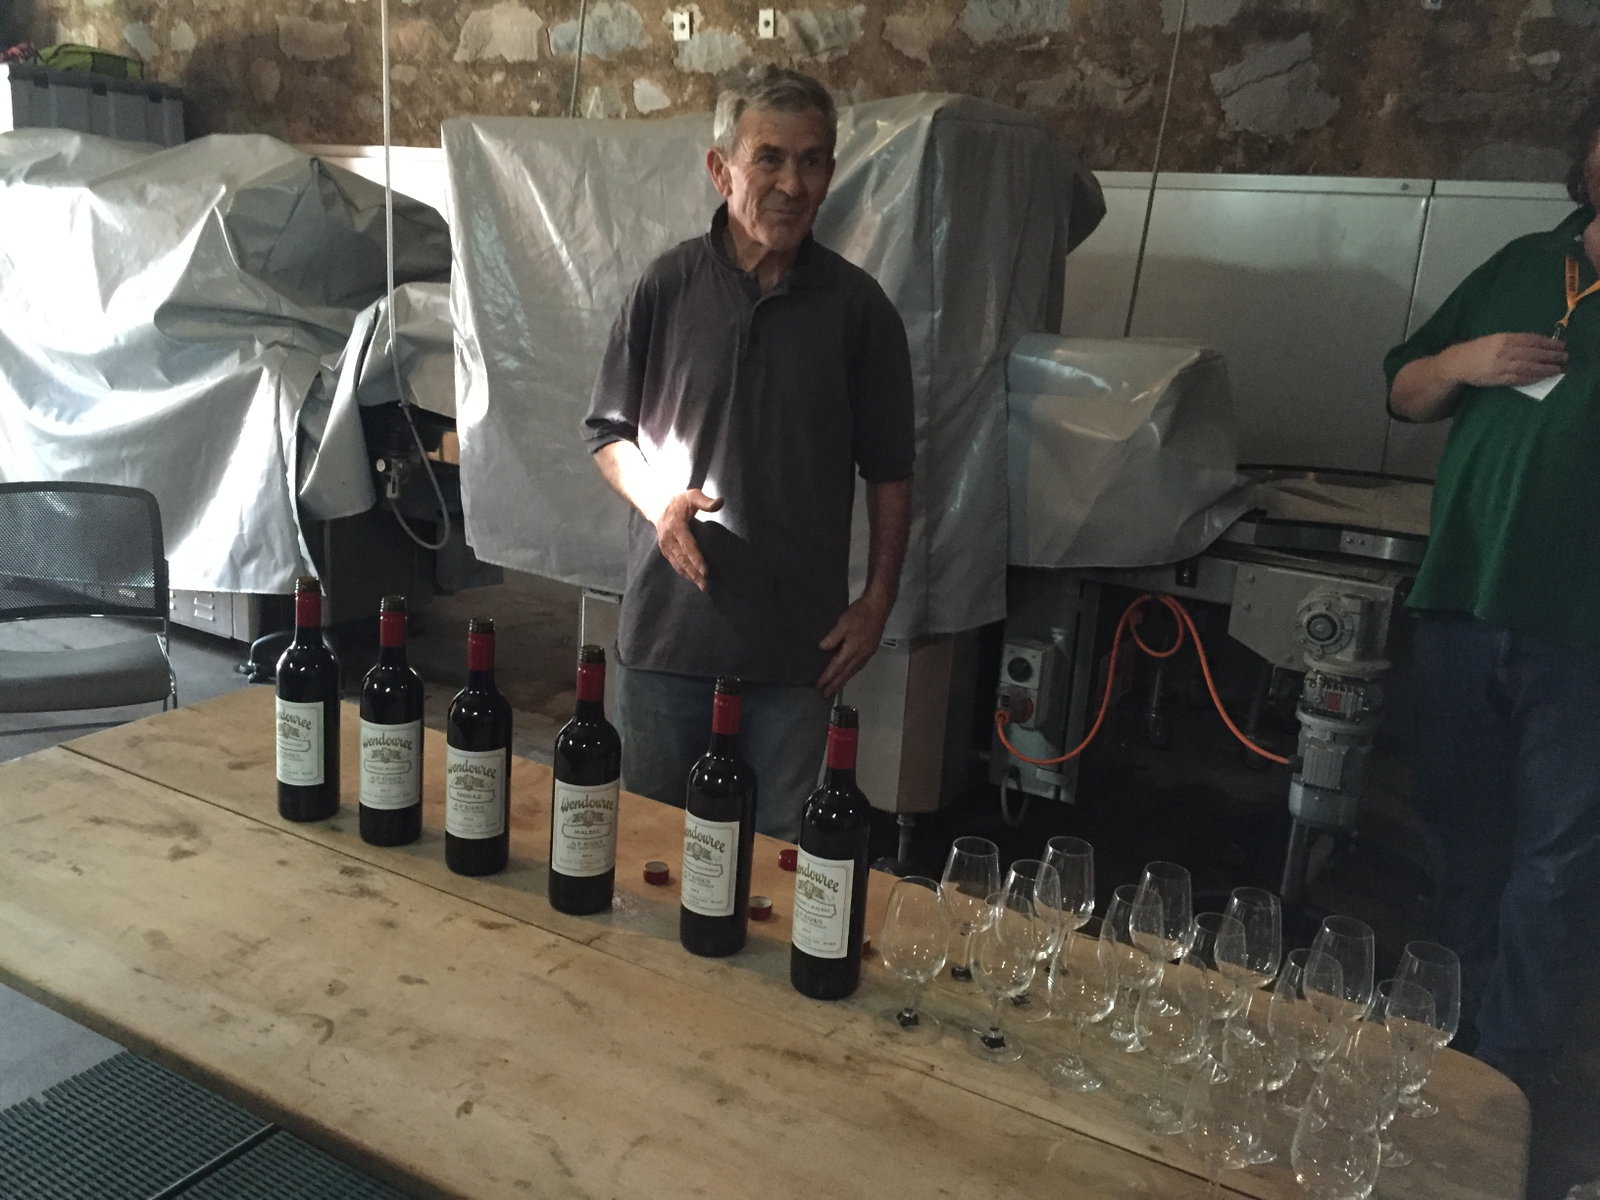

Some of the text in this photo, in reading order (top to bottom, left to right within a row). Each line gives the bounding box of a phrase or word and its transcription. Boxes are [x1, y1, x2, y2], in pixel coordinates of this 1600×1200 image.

[280, 708, 311, 730] douree
[561, 794, 614, 813] Wendouree
[685, 826, 726, 853] ndouree
[798, 863, 839, 893] endouree
